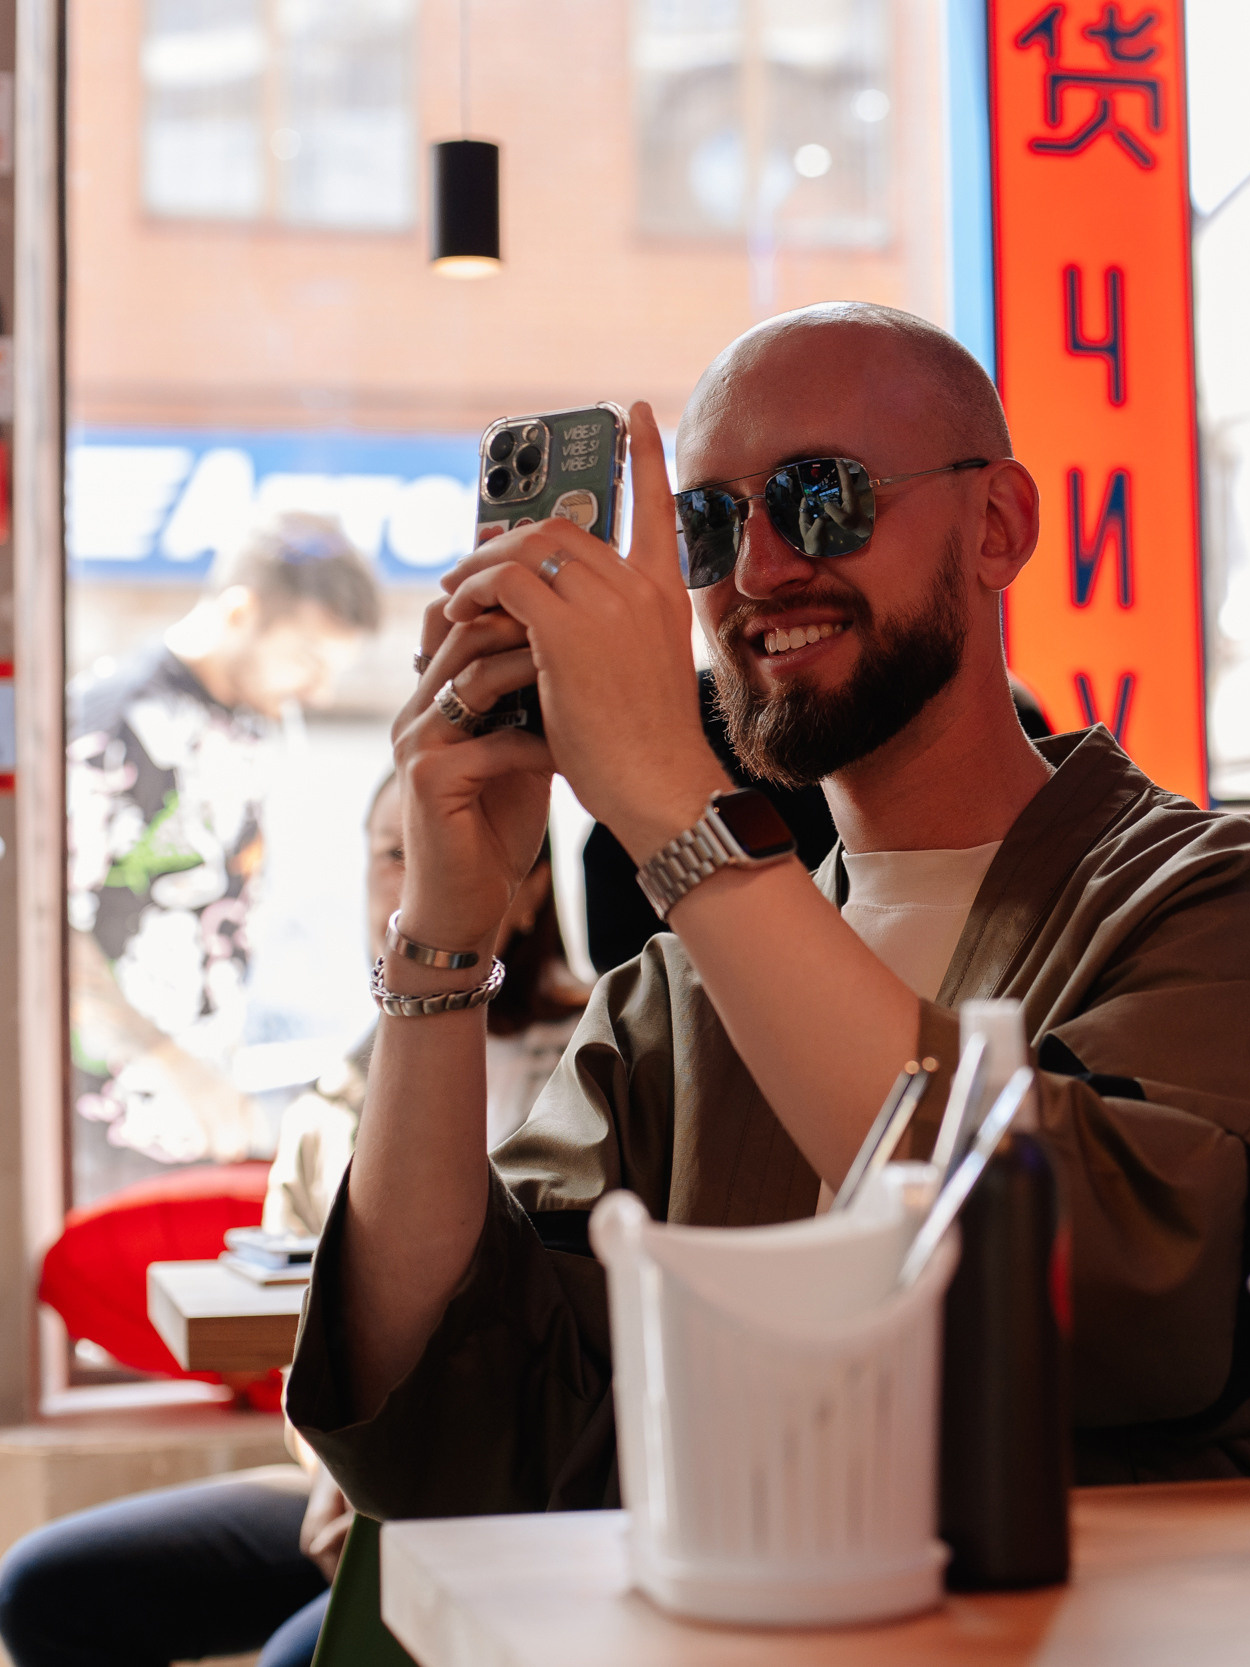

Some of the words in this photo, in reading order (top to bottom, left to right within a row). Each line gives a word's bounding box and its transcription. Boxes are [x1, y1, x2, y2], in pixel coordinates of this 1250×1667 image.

[1016, 5, 1162, 168] 货
[563, 424, 602, 440] VIBES!
[562, 440, 600, 456] VIBES!
[561, 455, 599, 471] VIBES!
